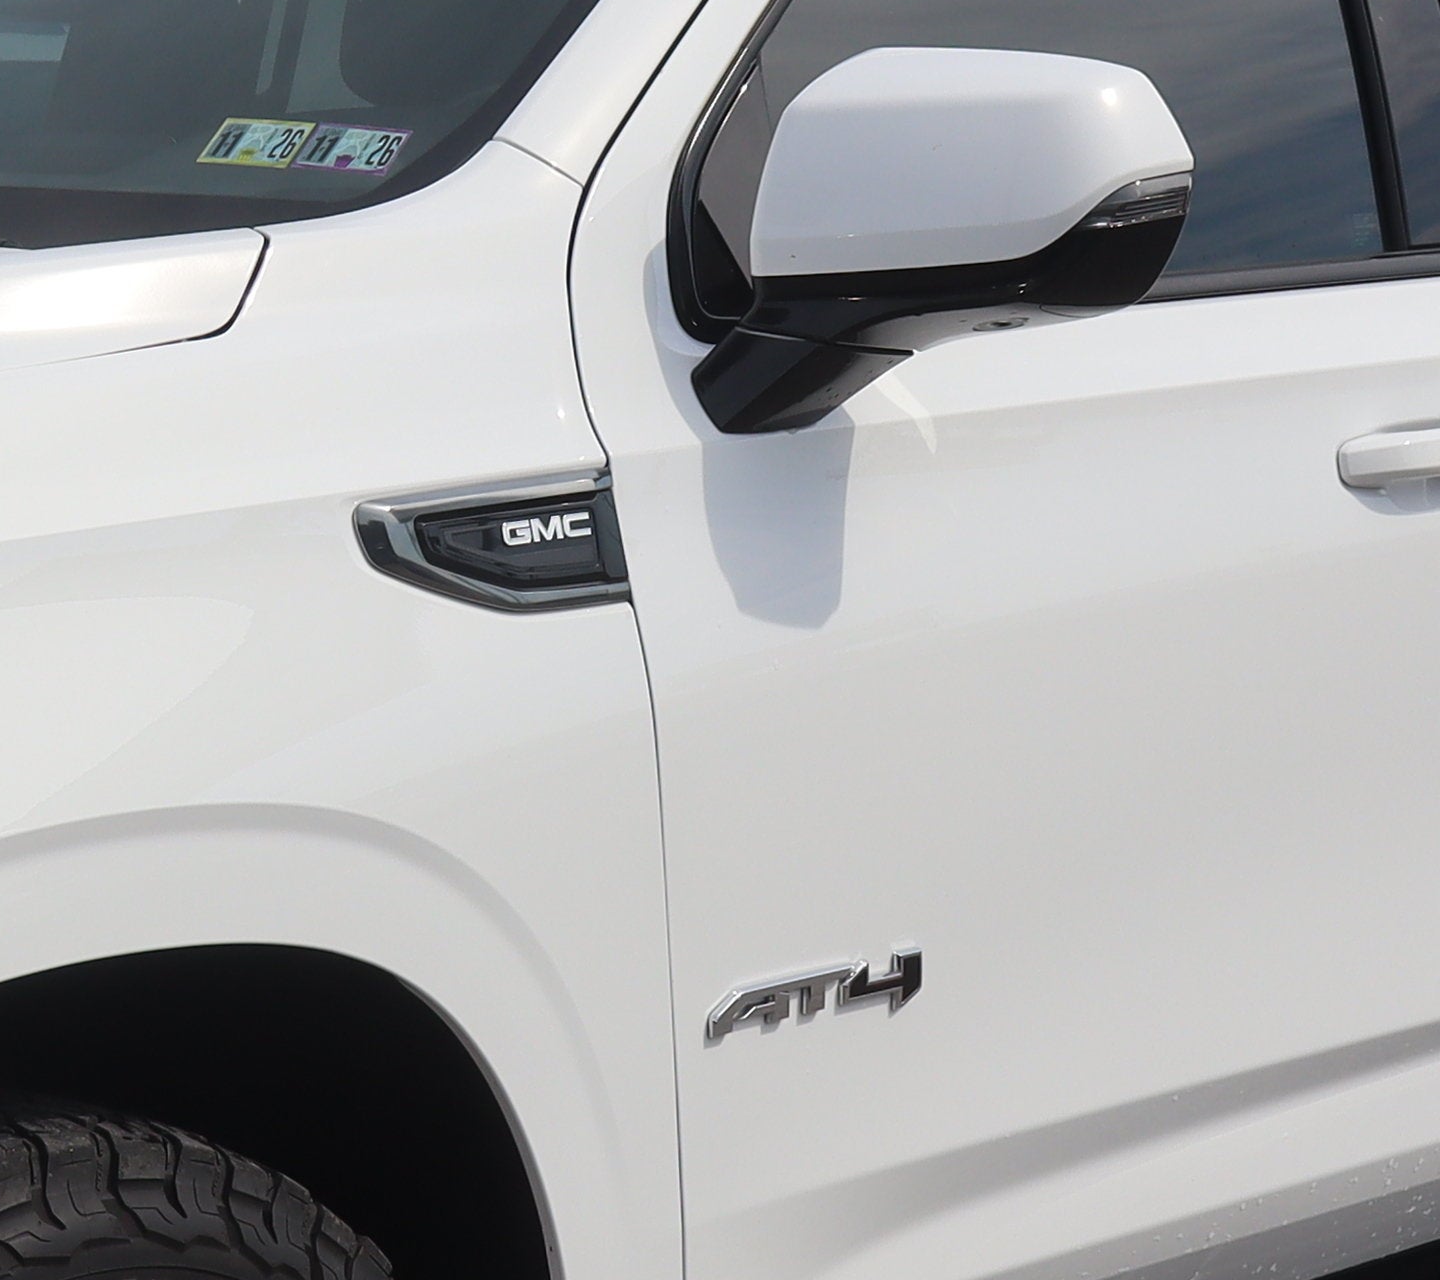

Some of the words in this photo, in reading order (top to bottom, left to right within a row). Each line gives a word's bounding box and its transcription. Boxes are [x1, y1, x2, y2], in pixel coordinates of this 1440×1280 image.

[267, 128, 306, 159] 26
[365, 134, 403, 167] 26
[501, 512, 593, 547] GMC
[706, 946, 922, 1041] AT4
